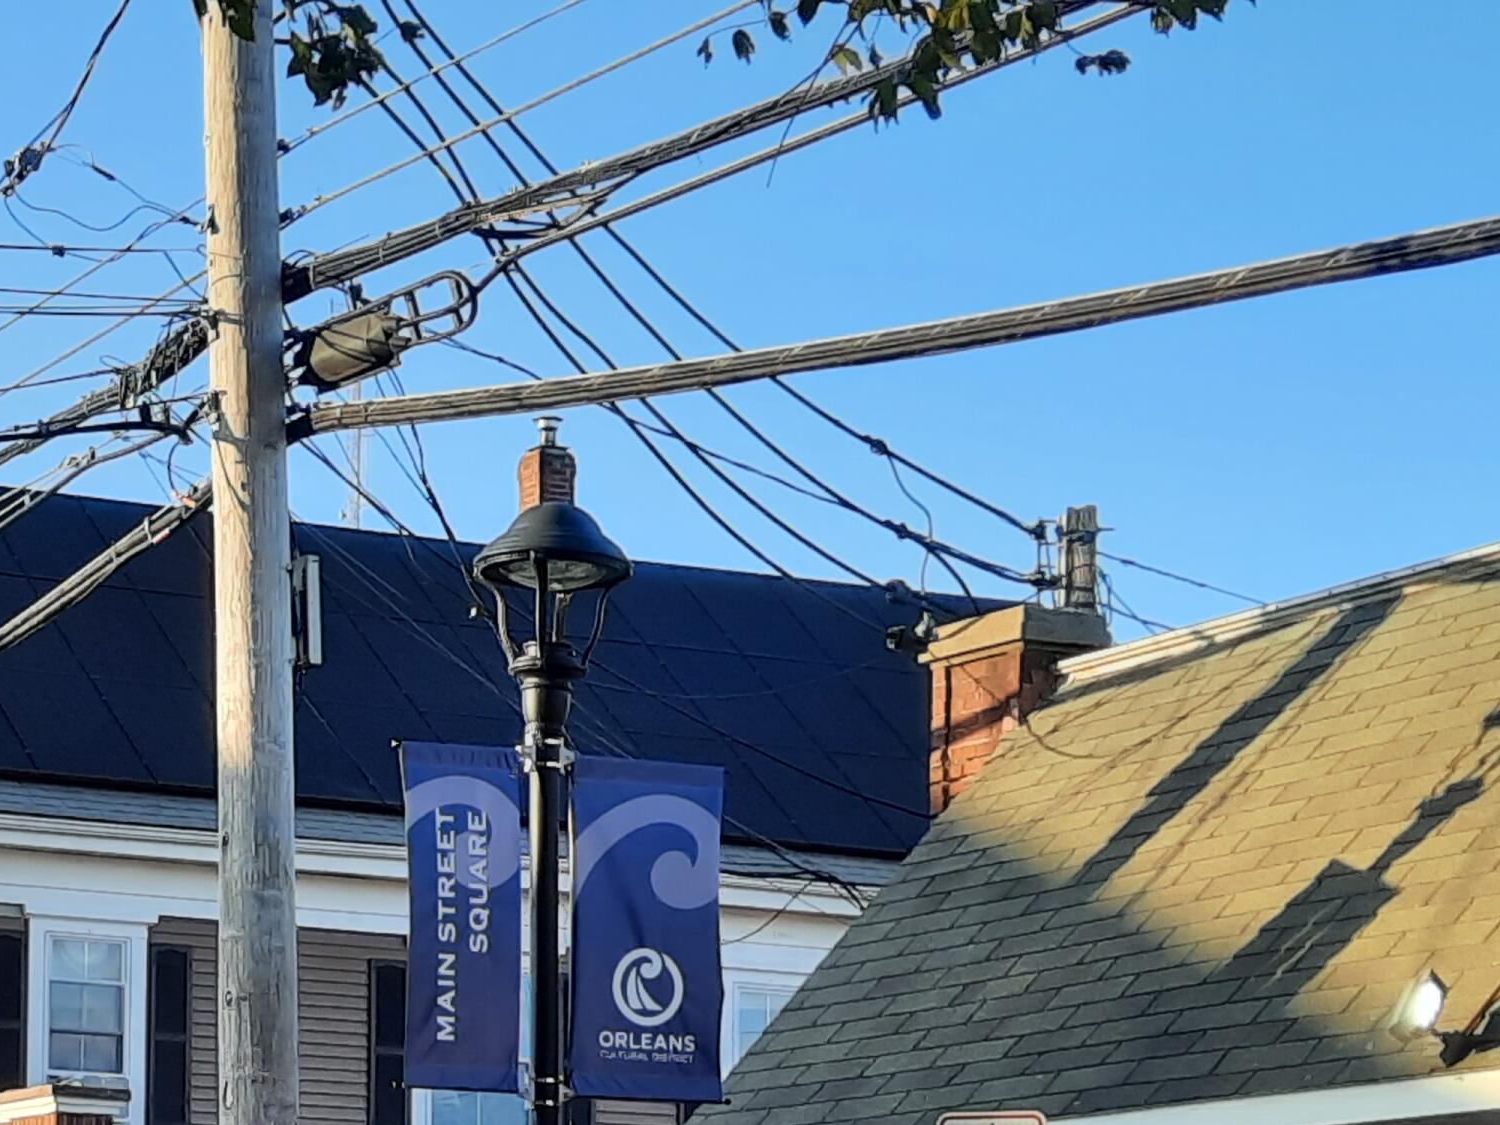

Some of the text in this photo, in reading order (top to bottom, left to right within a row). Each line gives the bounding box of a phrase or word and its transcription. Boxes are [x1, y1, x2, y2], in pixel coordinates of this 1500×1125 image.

[435, 806, 457, 1042] MAIN STREET
[467, 810, 490, 953] SQUARE
[599, 1030, 696, 1053] ORLEANS
